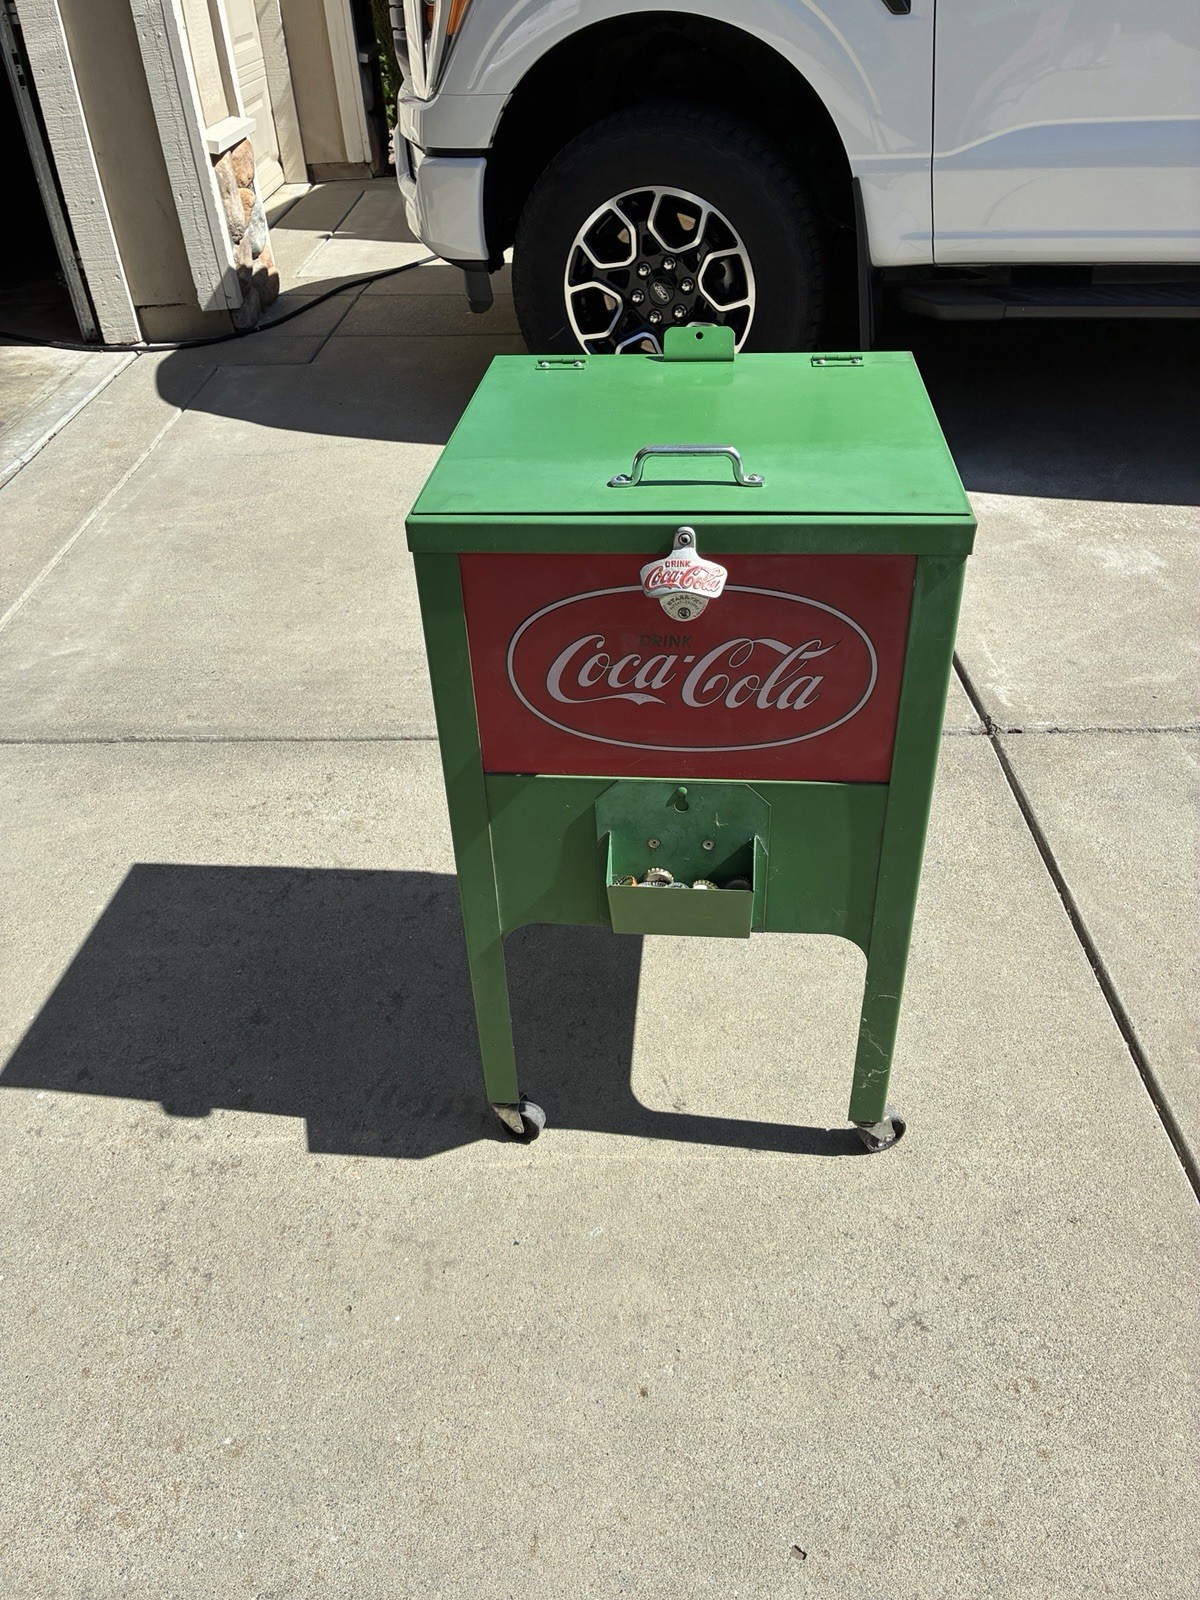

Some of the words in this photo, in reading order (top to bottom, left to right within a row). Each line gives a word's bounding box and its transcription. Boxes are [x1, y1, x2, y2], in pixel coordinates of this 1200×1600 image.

[665, 560, 691, 568] DRINK
[644, 565, 724, 592] Coca-Cola
[640, 632, 693, 648] DRINK
[546, 634, 843, 710] Coca-Cola
